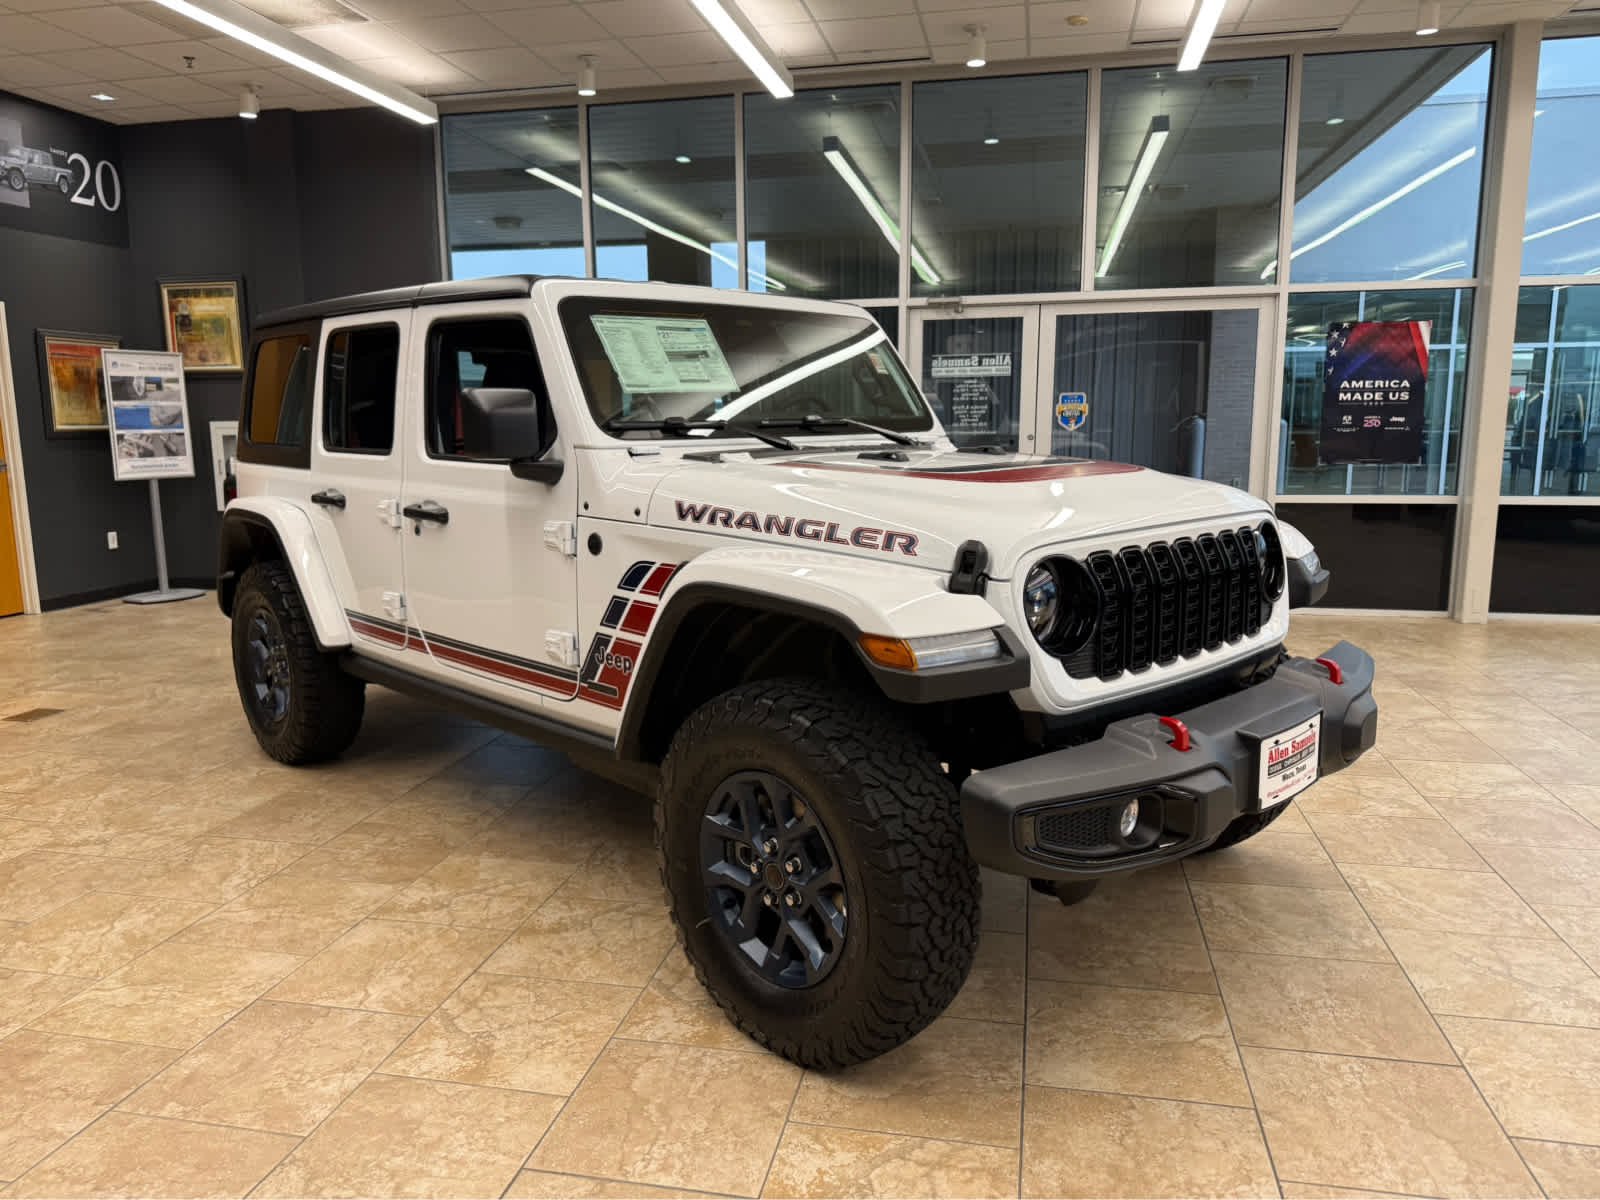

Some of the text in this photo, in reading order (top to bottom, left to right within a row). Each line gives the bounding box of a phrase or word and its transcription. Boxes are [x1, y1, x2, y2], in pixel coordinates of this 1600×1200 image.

[67, 153, 121, 212] 20
[1340, 380, 1410, 388] AMERICA
[1338, 392, 1410, 400] MADE US
[674, 500, 920, 557] WRANGLER
[595, 646, 634, 676] Jeep
[1268, 746, 1289, 763] Allen
